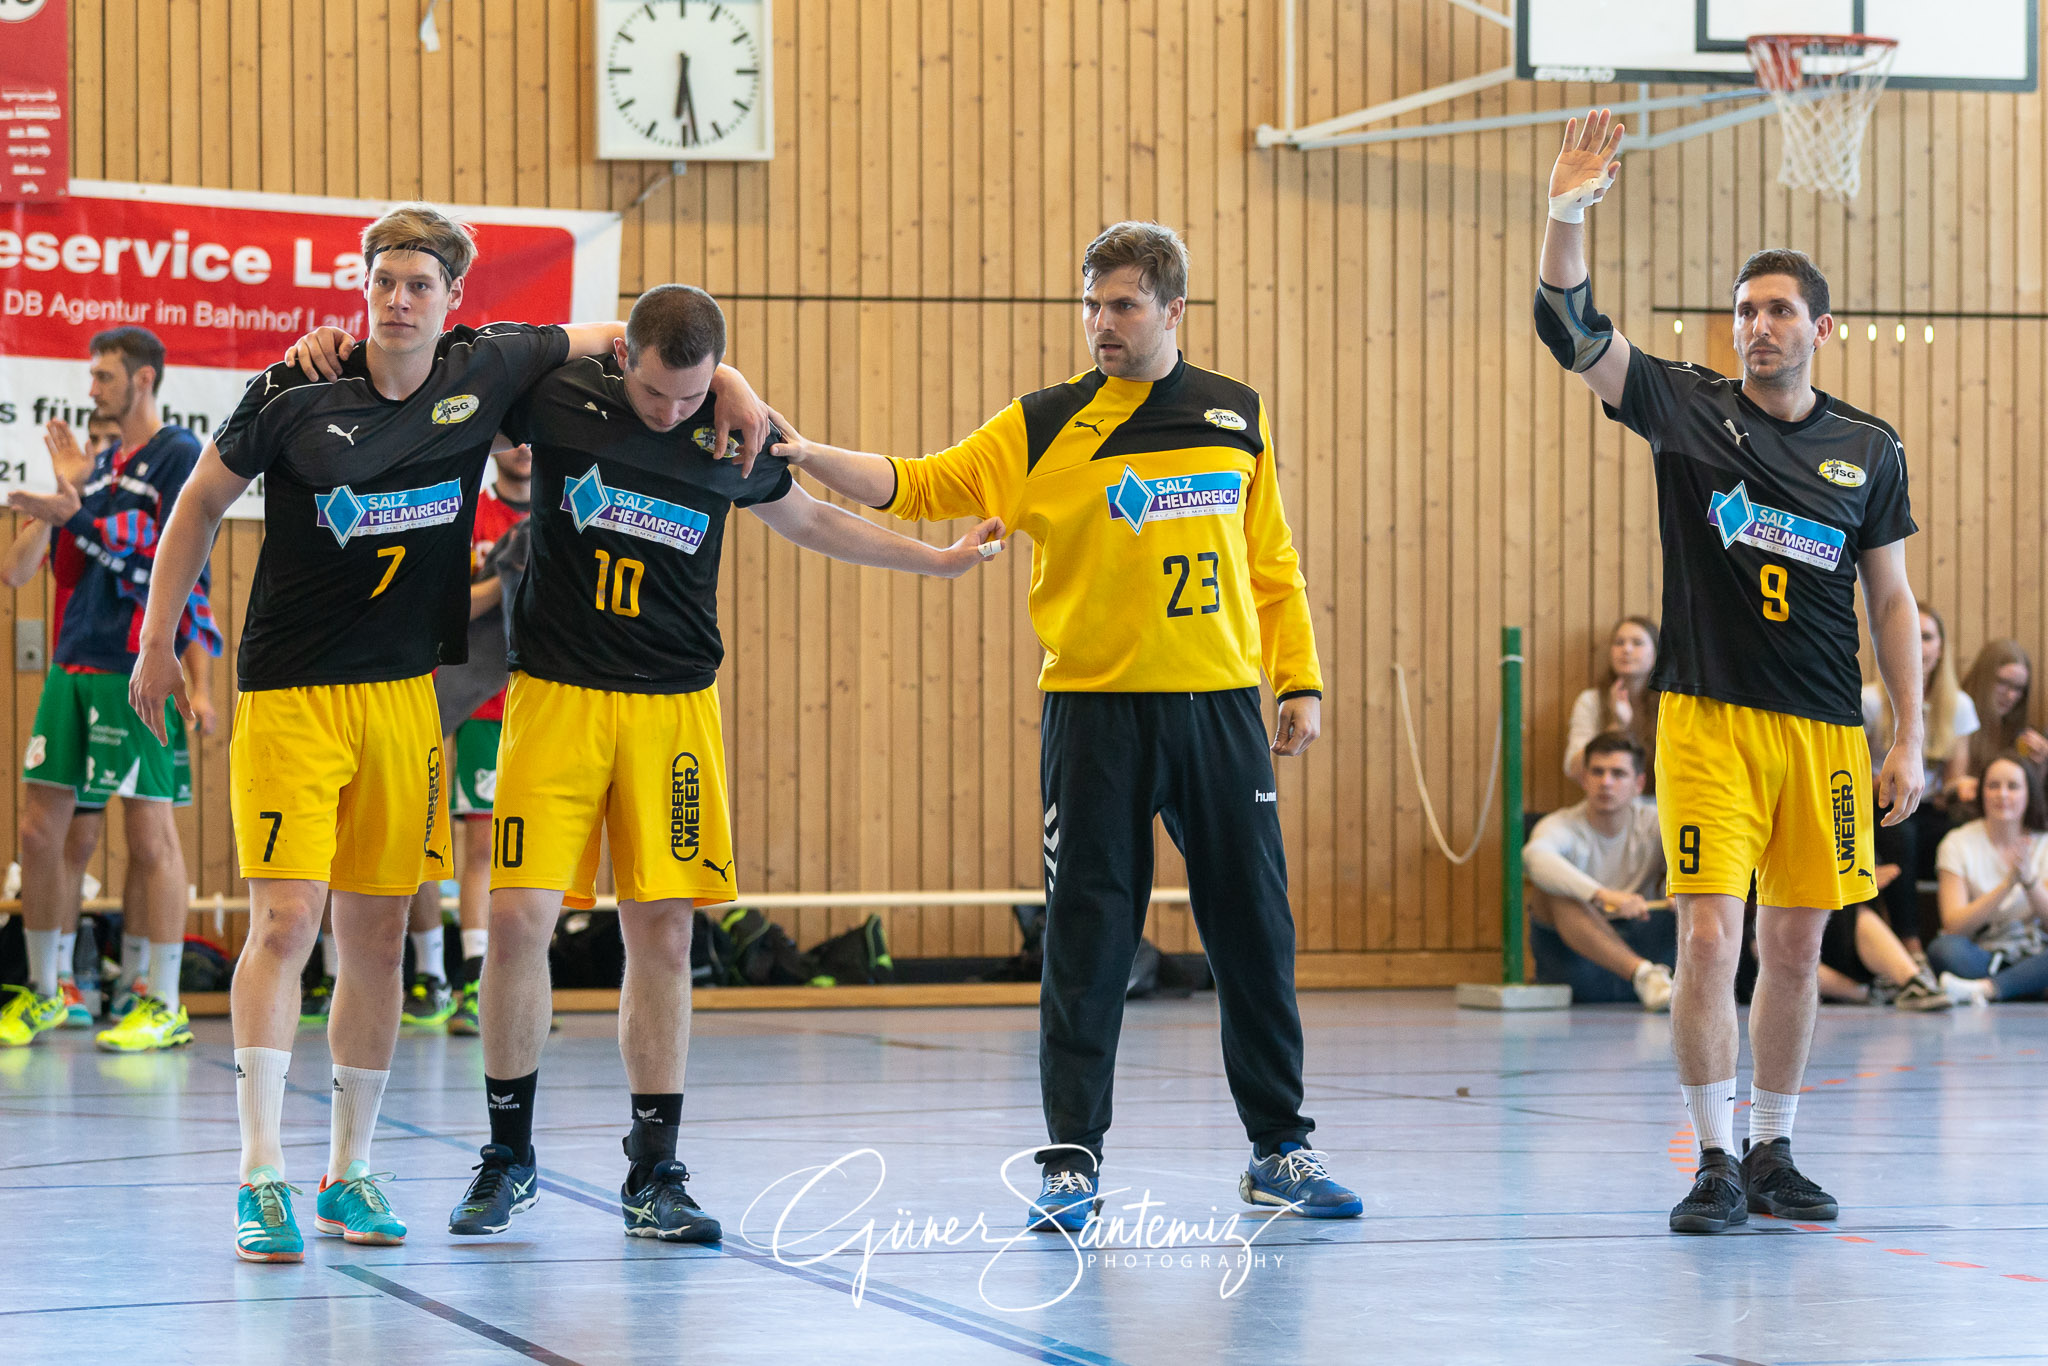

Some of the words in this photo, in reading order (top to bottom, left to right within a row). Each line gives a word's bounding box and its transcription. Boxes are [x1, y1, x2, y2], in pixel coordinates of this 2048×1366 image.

[0, 229, 271, 285] eservice
[293, 238, 365, 290] La
[4, 288, 43, 316] DB
[47, 291, 151, 325] Agentur
[155, 298, 187, 326] im
[194, 299, 303, 334] Bahnhof
[306, 306, 364, 335] Lauf
[162, 404, 208, 434] hn
[442, 402, 470, 416] HSG
[1156, 478, 1194, 494] SALZ
[1830, 467, 1856, 479] HSG
[369, 493, 409, 510] SALZ
[369, 497, 459, 525] HELMREICH
[613, 492, 655, 514] SALZ
[1158, 489, 1239, 510] HELMREICH
[1757, 509, 1796, 531] SALZ
[610, 507, 701, 545] HELMREICH
[1753, 523, 1838, 561] HELMREICH
[368, 545, 406, 600] 7
[595, 549, 645, 618] 10
[1163, 552, 1220, 618] 23
[1760, 564, 1789, 622] 9
[671, 767, 684, 847] ROBERT
[684, 766, 700, 847] MEIER
[1255, 789, 1277, 802] hum
[260, 812, 282, 862] 7
[494, 816, 524, 869] 10
[1841, 784, 1855, 860] MEIER
[1679, 825, 1700, 875] 9
